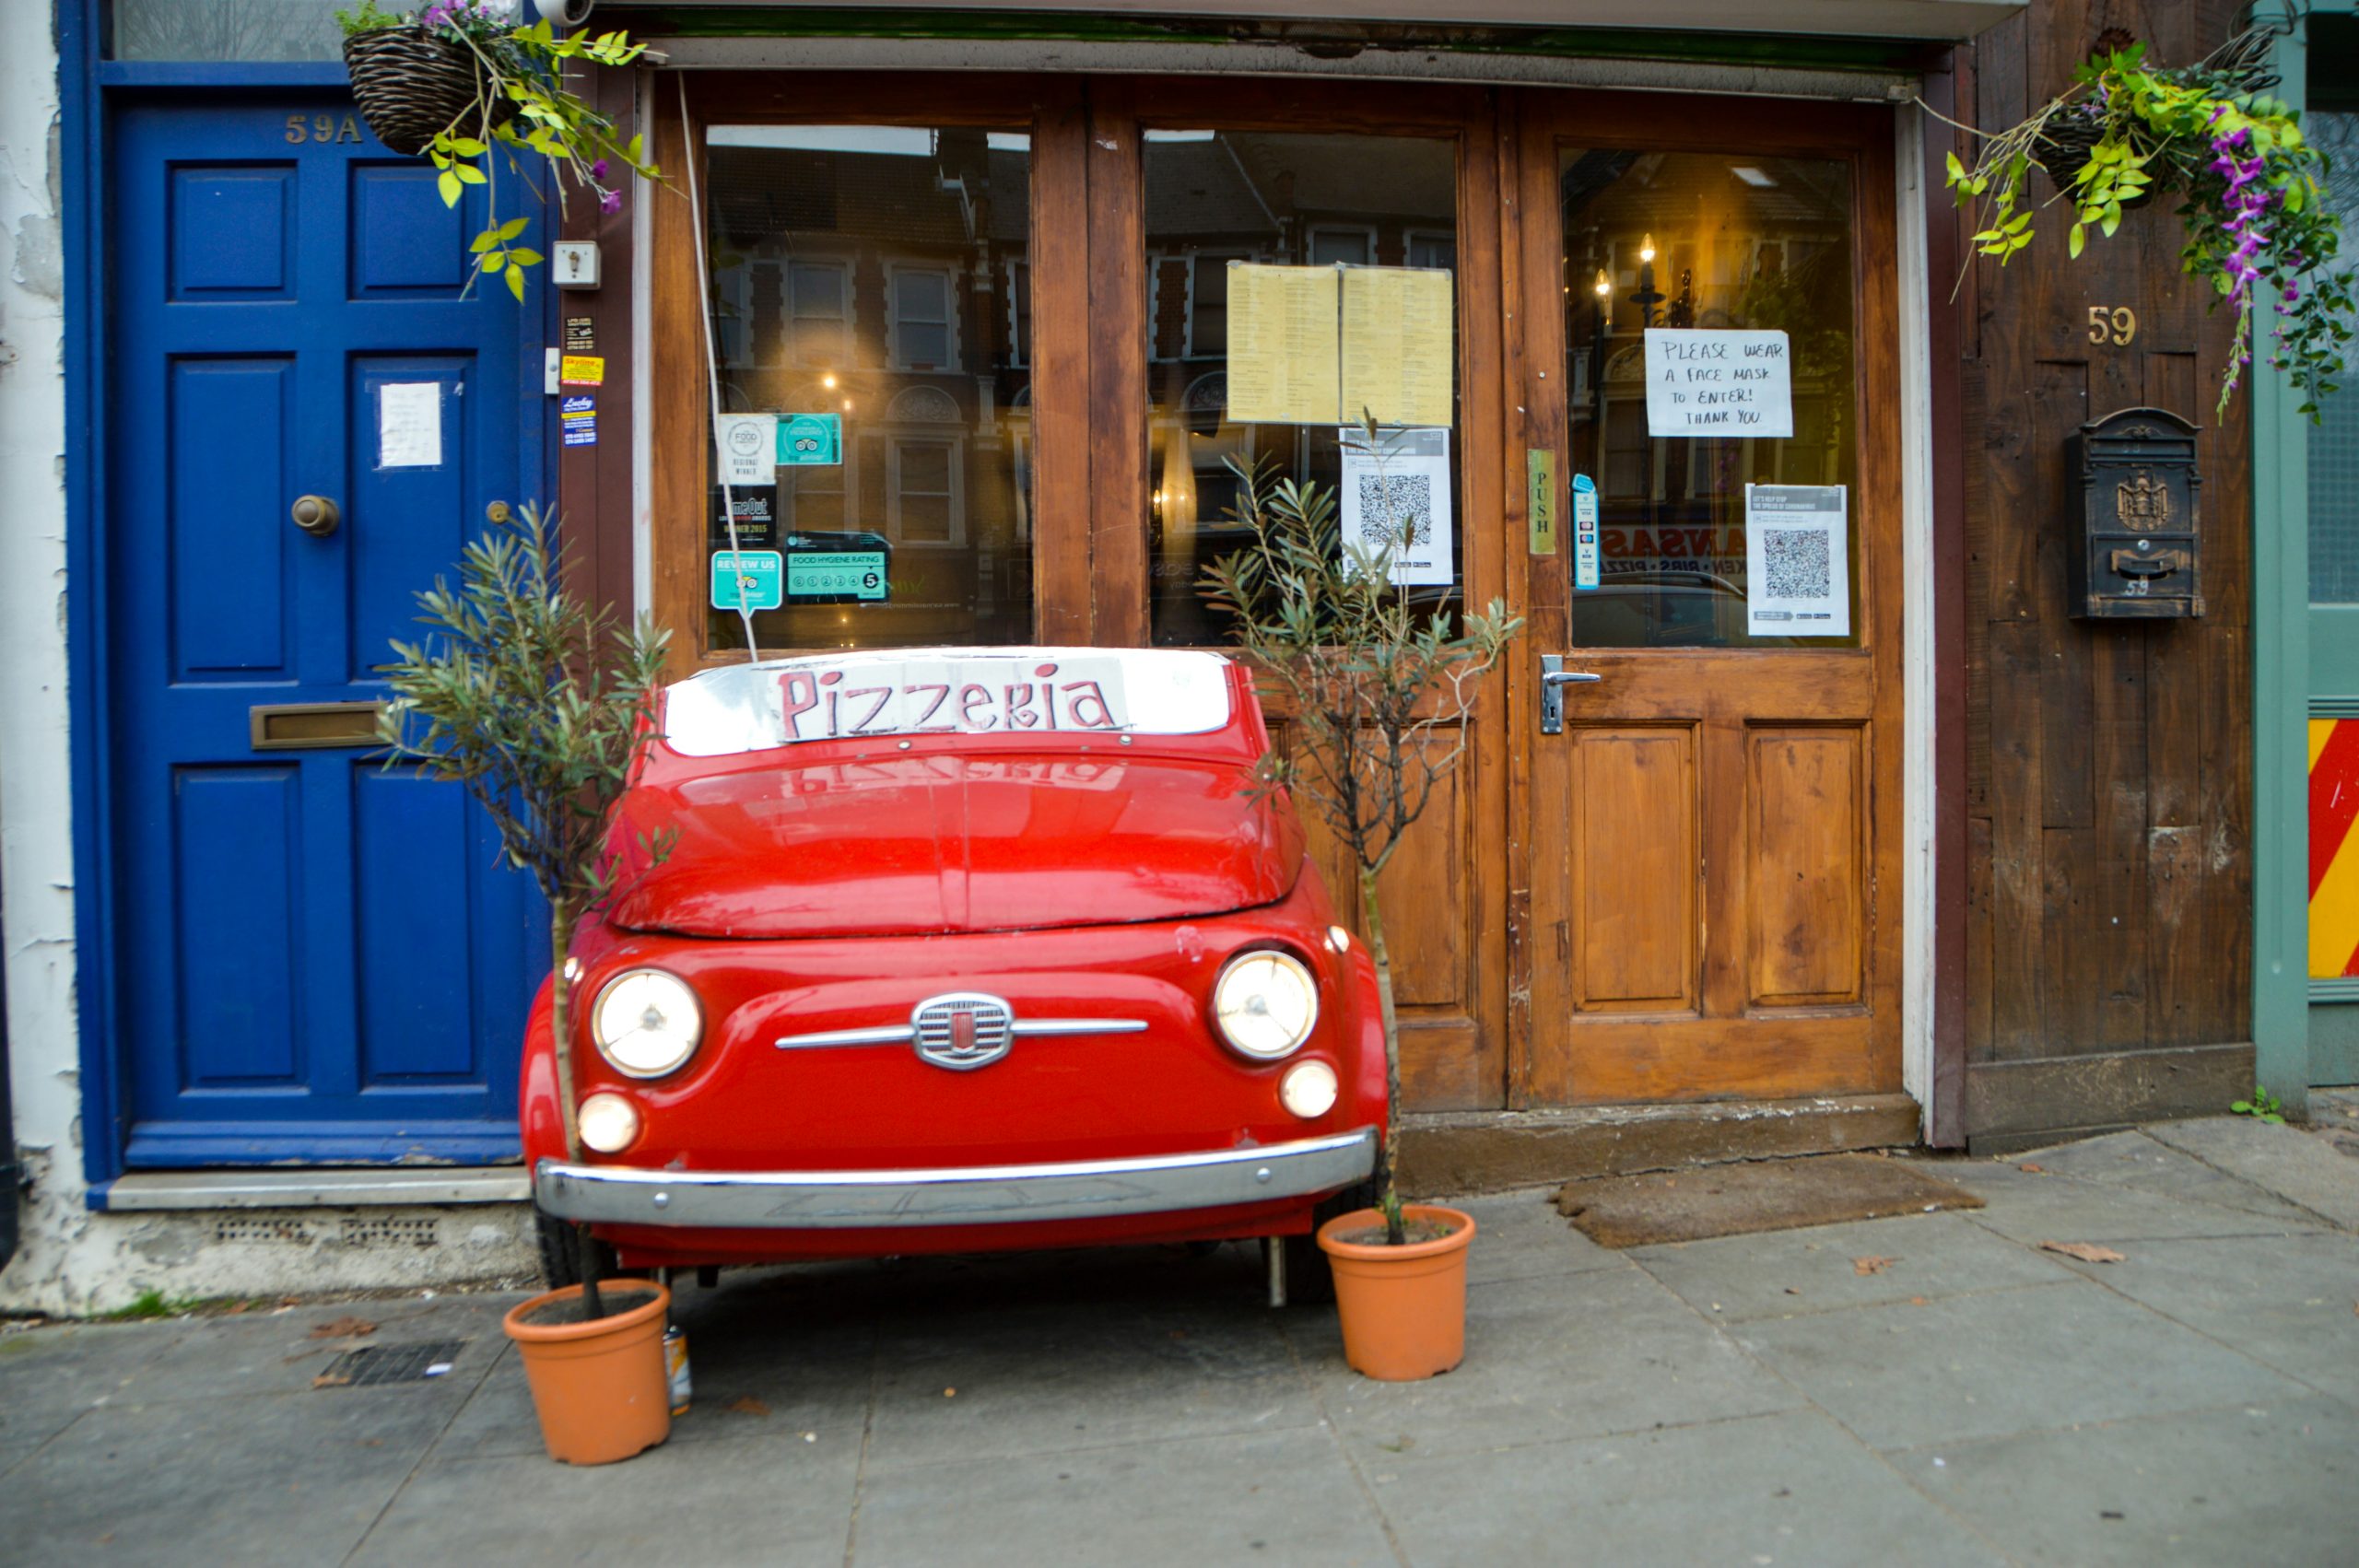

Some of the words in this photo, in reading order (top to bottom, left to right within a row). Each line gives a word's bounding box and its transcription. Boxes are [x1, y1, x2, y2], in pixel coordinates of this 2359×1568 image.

[285, 114, 363, 144] 59A
[2088, 306, 2136, 346] 59
[1661, 342, 1729, 360] PLEASE
[1744, 344, 1783, 358] WEAR
[1665, 369, 1674, 382] A
[1687, 368, 1722, 382] FACE
[1733, 368, 1770, 380] MASK
[1671, 392, 1686, 404] TO
[1697, 389, 1753, 404] ENTER!
[1685, 412, 1729, 425] THANK
[724, 497, 768, 515] meOut
[1537, 473, 1548, 533] PUSH
[716, 559, 758, 569] REVEW
[760, 559, 776, 569] US
[865, 574, 875, 587] 5
[2125, 579, 2149, 597] 59
